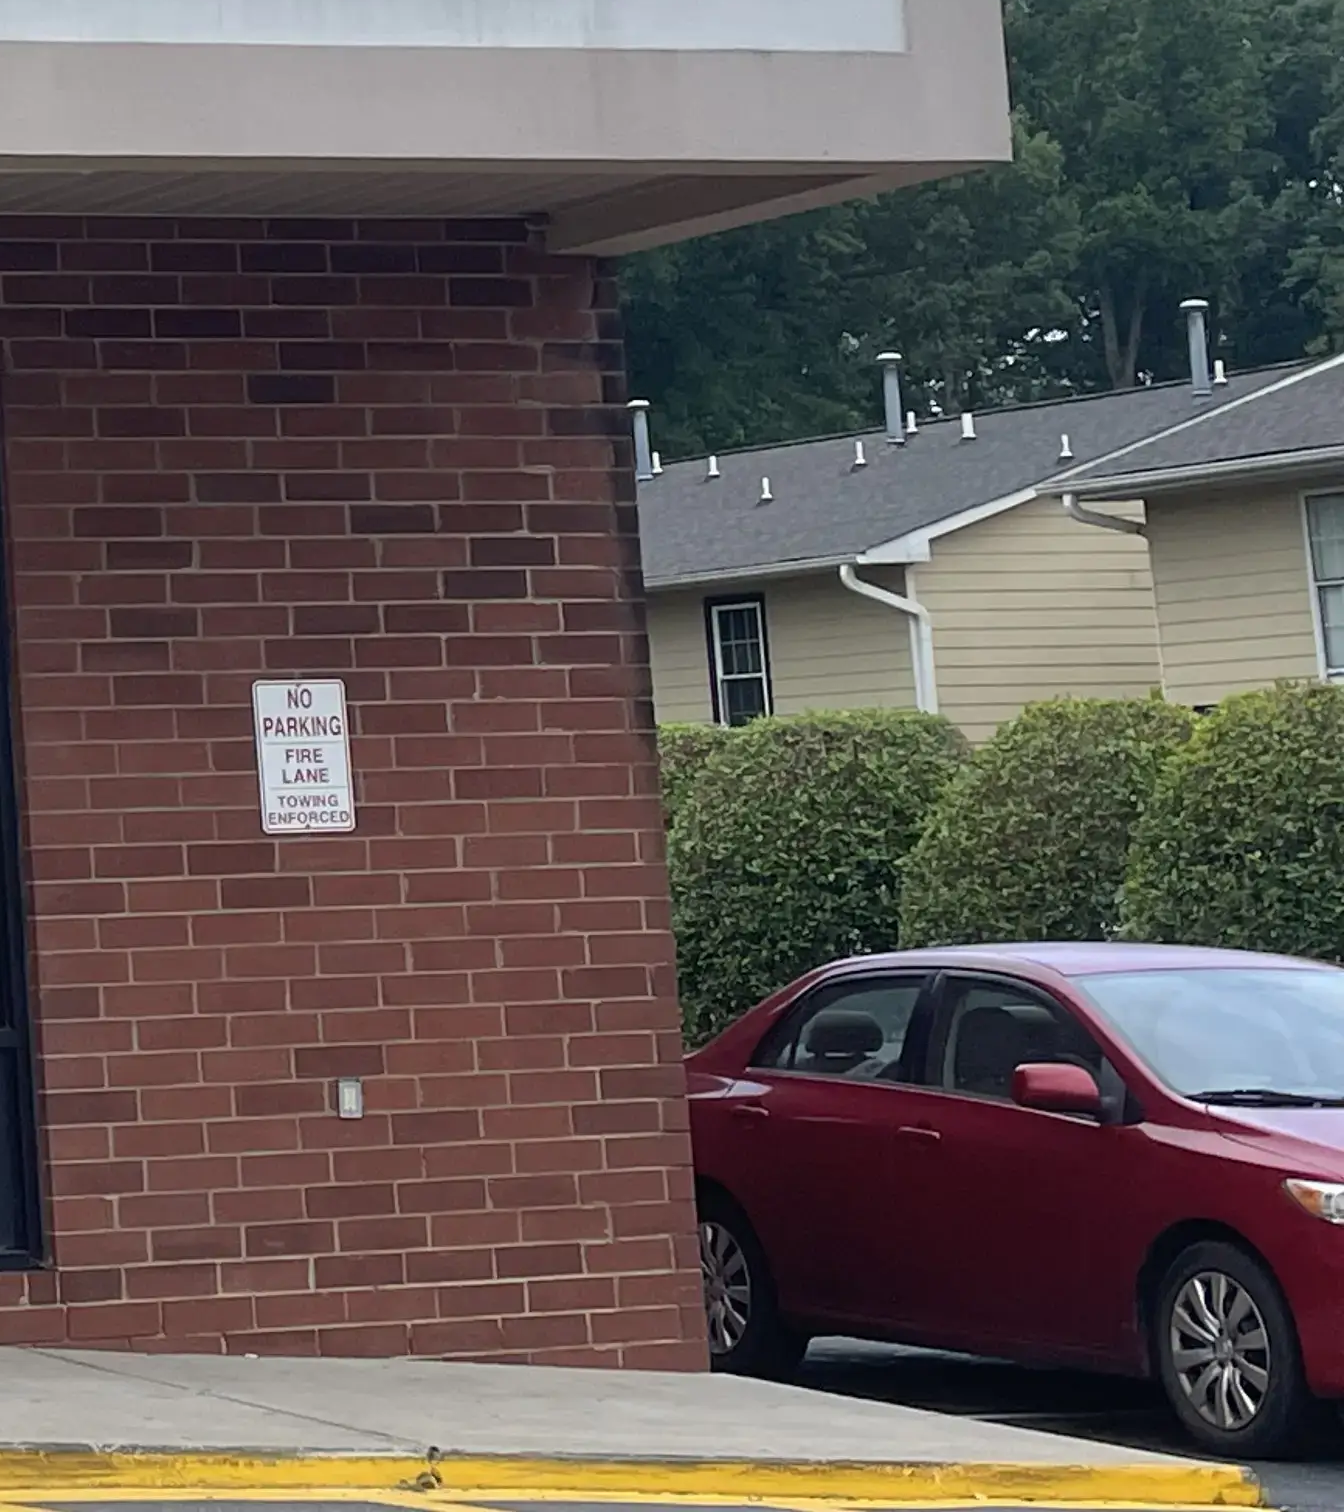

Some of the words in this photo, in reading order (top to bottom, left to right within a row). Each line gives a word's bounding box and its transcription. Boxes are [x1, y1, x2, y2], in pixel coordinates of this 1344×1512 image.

[287, 688, 312, 709] NO
[263, 715, 341, 737] PARKING
[285, 748, 324, 763] FIRE
[282, 768, 330, 784] LANE
[277, 794, 339, 808] TOWING
[269, 810, 349, 825] ENFORCED
